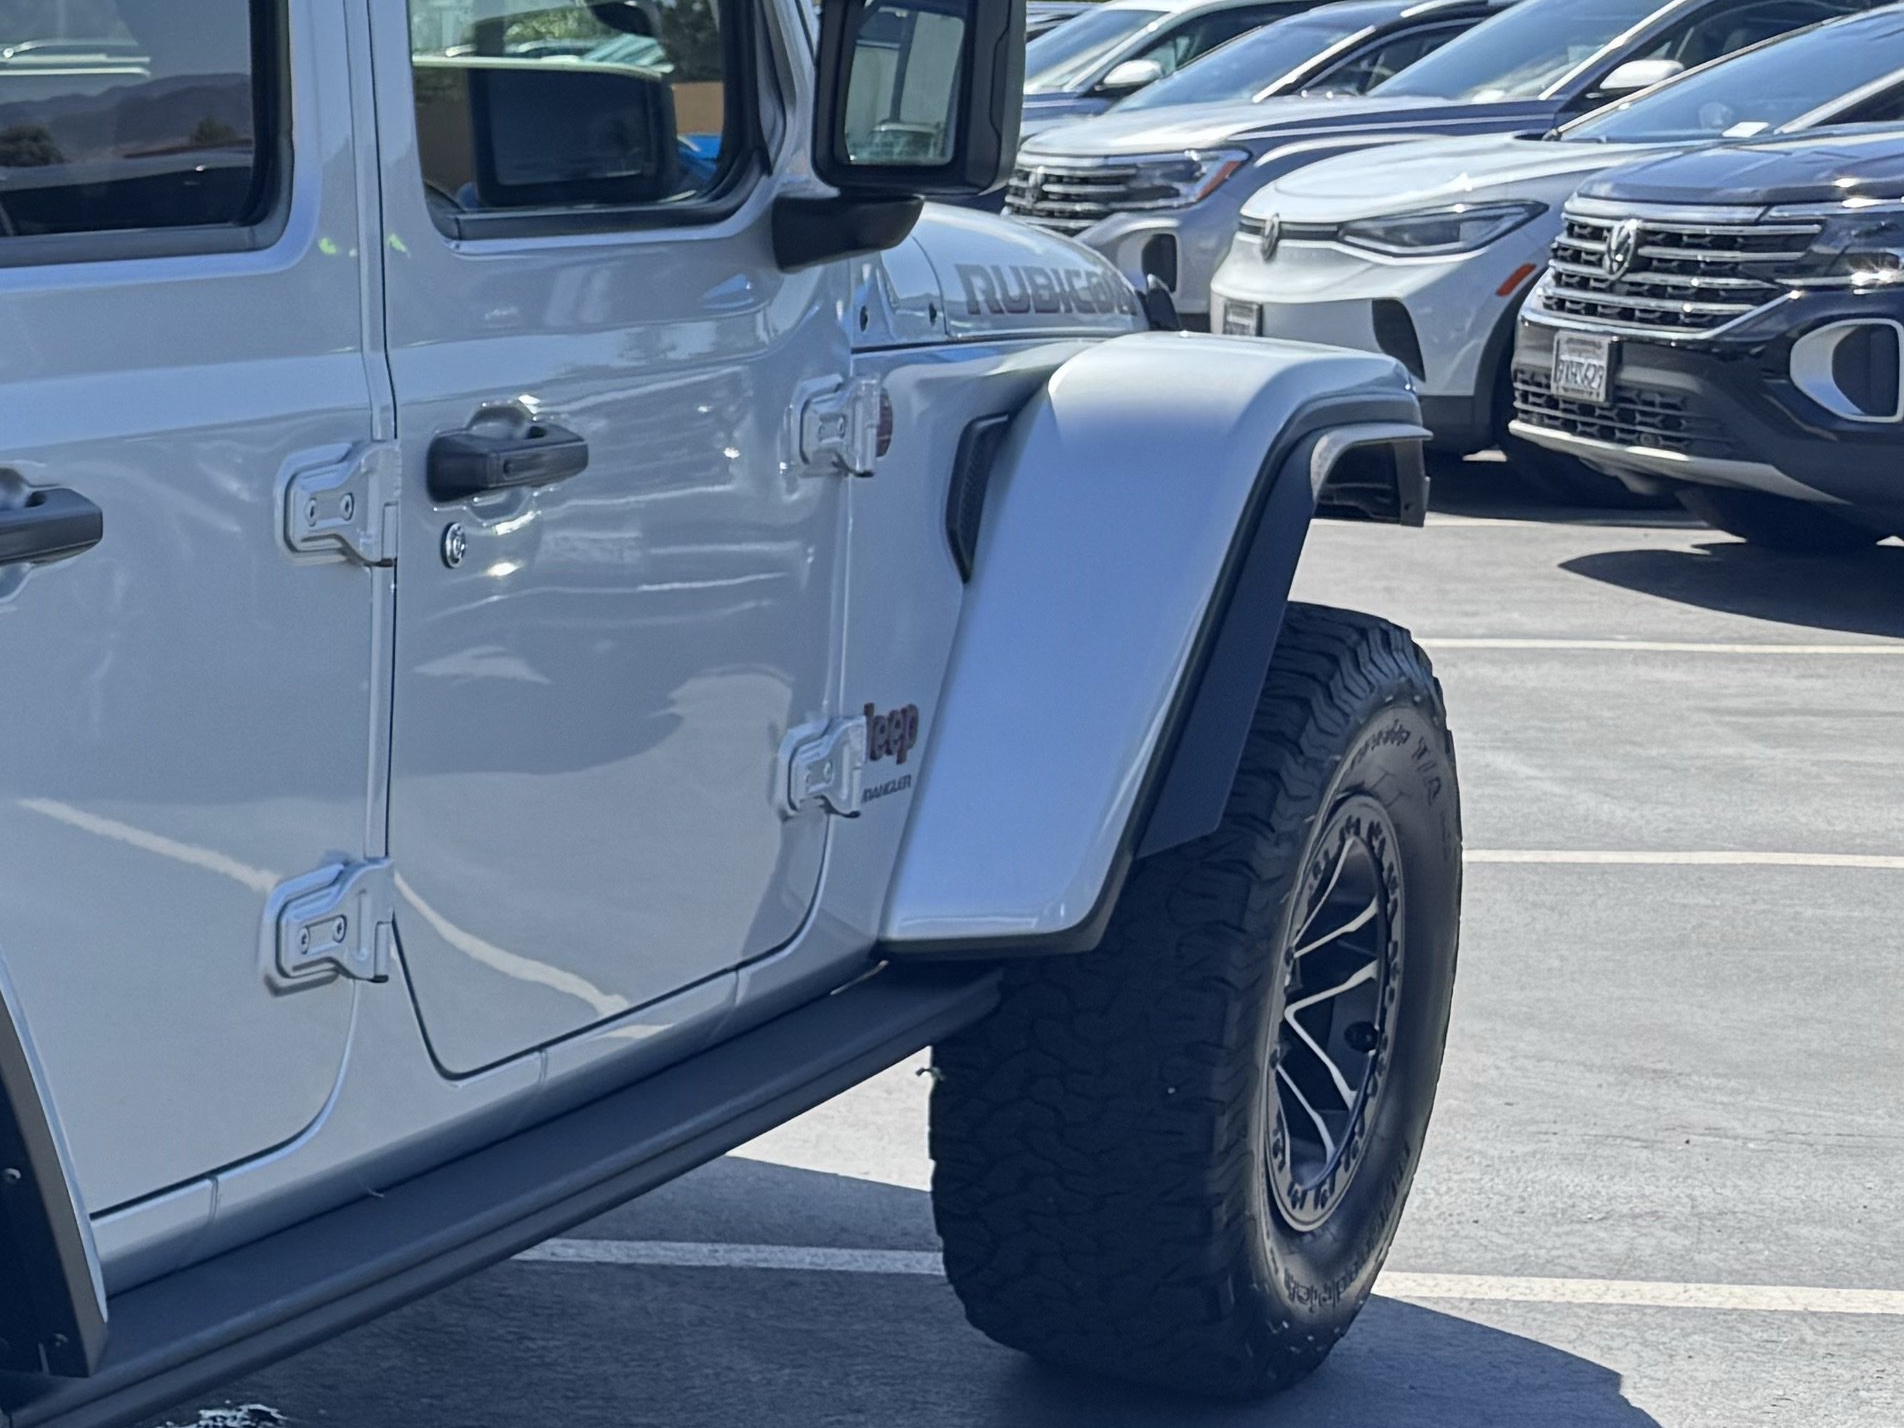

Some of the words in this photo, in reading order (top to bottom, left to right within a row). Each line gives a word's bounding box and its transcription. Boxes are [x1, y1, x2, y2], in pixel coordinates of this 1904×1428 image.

[954, 264, 1138, 316] RUBICON
[863, 702, 919, 765] Jeep
[861, 774, 912, 803] RANGLER
